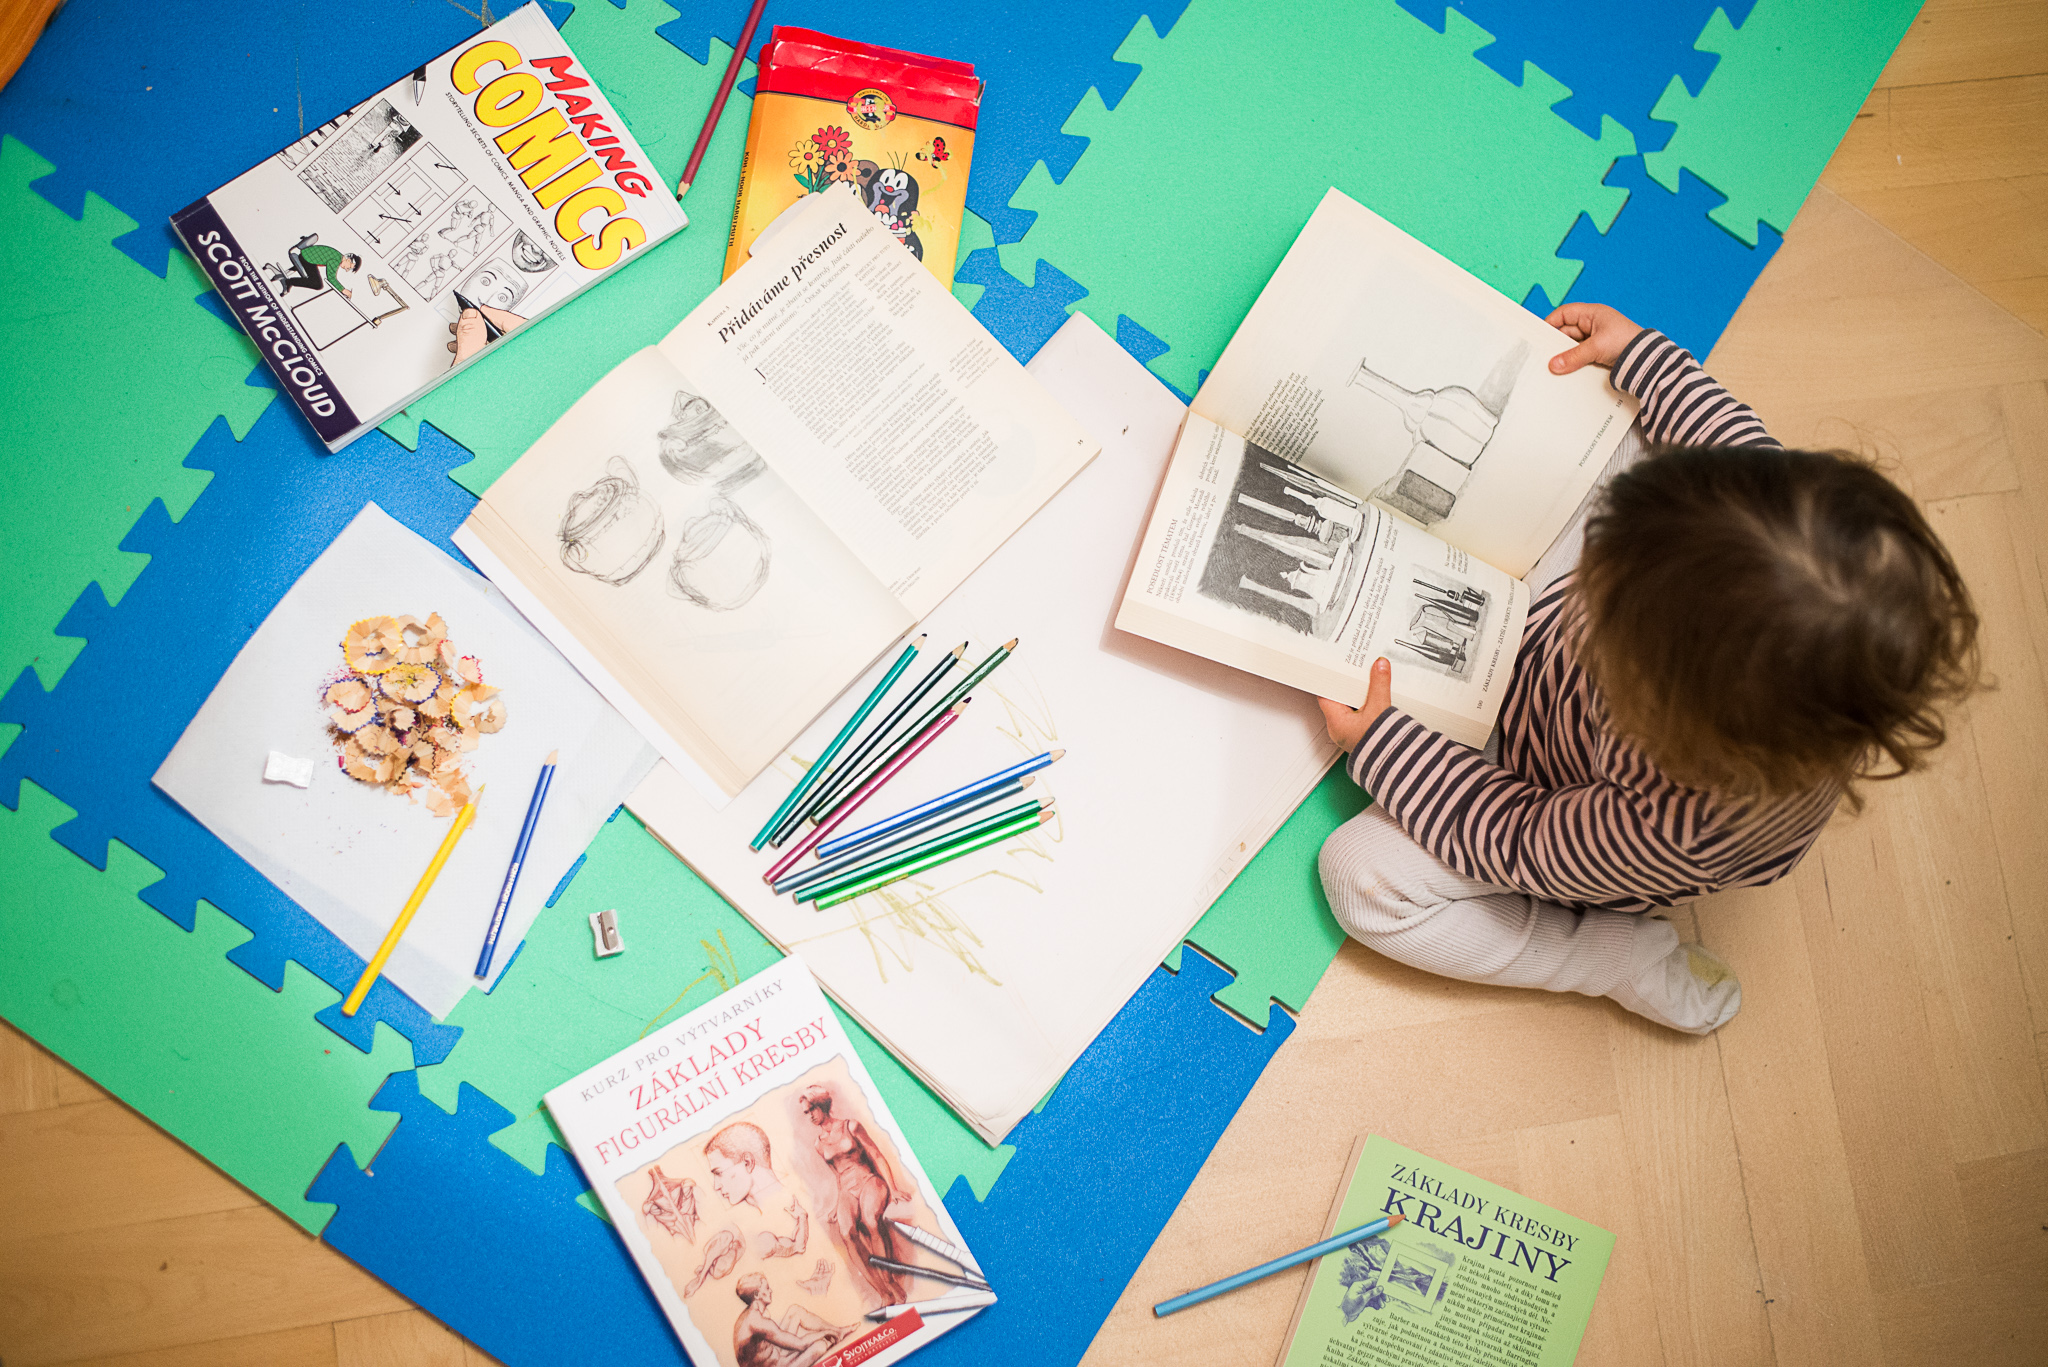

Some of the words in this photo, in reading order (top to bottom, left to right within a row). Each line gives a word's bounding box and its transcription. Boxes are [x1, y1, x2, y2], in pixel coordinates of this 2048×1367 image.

[445, 91, 473, 128] STORYTELLING
[469, 127, 488, 150] SECRETS
[490, 157, 510, 181] COMICS,
[507, 181, 525, 204] MANGA
[522, 204, 534, 216] AND
[531, 215, 552, 240] GRAPHIC
[548, 239, 566, 261] NOVELS
[451, 40, 646, 271] COMICS
[529, 55, 654, 199] MAKING
[736, 151, 750, 198] KOH-I-NOOR
[718, 275, 790, 344] Přidáváme
[790, 222, 848, 283] přesnost
[728, 199, 742, 247] HARDTMUTH
[197, 230, 261, 300] SCOTT
[245, 304, 336, 417] McCLOUD
[238, 255, 253, 273] FROM
[249, 270, 260, 282] THE
[255, 281, 274, 304] AUTHOR
[275, 310, 308, 354] UNDERSTANDING
[304, 352, 326, 377] COMICS
[1578, 439, 1598, 468] POSEDLOST
[1595, 414, 1614, 440] TÉMATEM
[1146, 553, 1166, 595] POSEDLOST
[1160, 518, 1179, 553] TÉMATEM
[580, 1067, 630, 1102] KURZ
[634, 1045, 670, 1072] PRO
[675, 979, 783, 1046] VÝTVARNÍKY
[594, 1071, 729, 1166] FIGURÁLNÍ
[731, 1016, 828, 1087] KRESBY
[629, 1017, 764, 1111] ZÁKLADY
[1379, 1186, 1572, 1283] KRAJINY
[1390, 1163, 1489, 1215] ZÁKLADY
[1493, 1205, 1580, 1252] KRESBY
